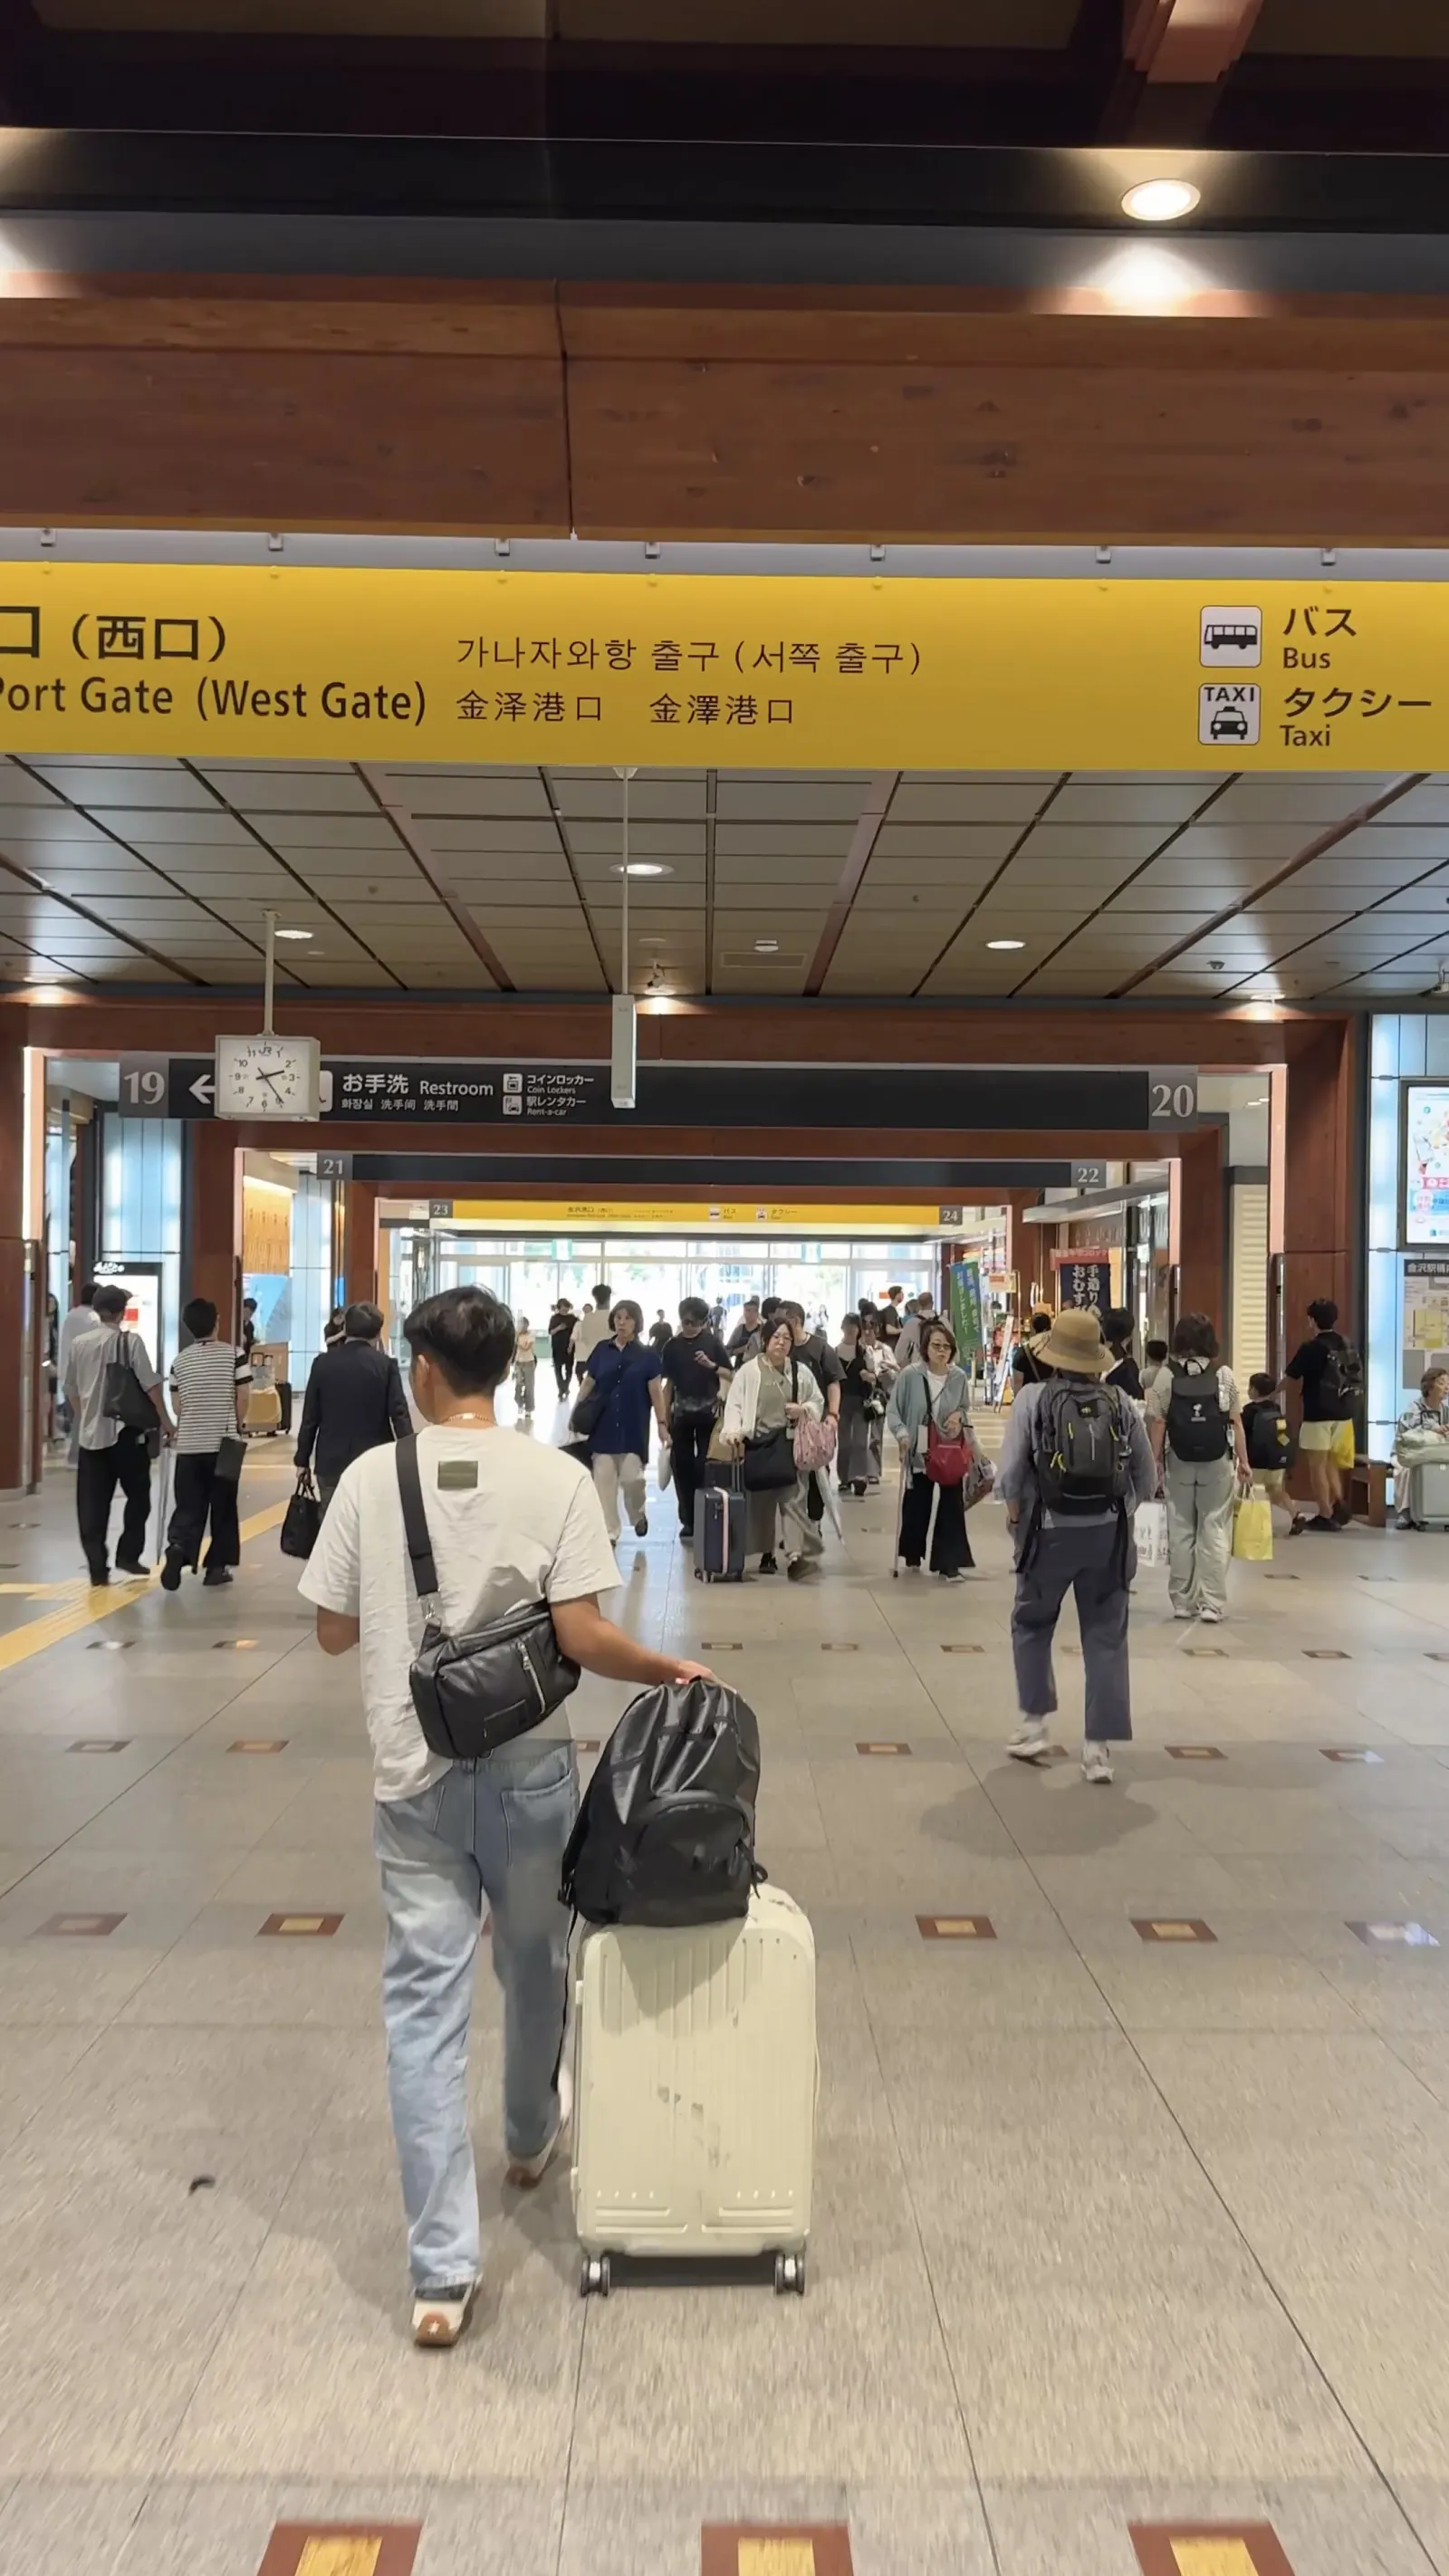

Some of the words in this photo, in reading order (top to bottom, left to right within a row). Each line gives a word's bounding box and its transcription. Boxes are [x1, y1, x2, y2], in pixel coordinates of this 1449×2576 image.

[1282, 606, 1357, 638] バス
[456, 636, 638, 670] 가나자와항
[651, 639, 720, 672] 출구
[734, 640, 820, 674] (서쪽
[835, 642, 921, 676] 출구)
[1282, 647, 1331, 670] Bus
[81, 676, 173, 715] Gate
[197, 678, 308, 722] (West
[321, 679, 426, 726] Gate)
[1204, 687, 1255, 703] TAXI
[1284, 687, 1433, 718] タクシー
[456, 689, 602, 723] 金泽港口
[649, 693, 793, 726] 金澤港口
[1280, 724, 1331, 748] Taxi
[238, 1059, 248, 1068] 10
[285, 1060, 292, 1069] 2
[235, 1072, 242, 1081] 9
[289, 1073, 295, 1081] 3
[342, 1073, 409, 1094] お手洗
[527, 1074, 595, 1085] コインロッカー
[123, 1071, 165, 1104] 19
[238, 1086, 245, 1094] 8
[285, 1087, 291, 1095] 4
[419, 1080, 494, 1096] Restroom
[527, 1086, 545, 1094] Coin
[547, 1087, 576, 1095] Lockers
[247, 1096, 254, 1104] 7
[261, 1100, 268, 1109] 6
[526, 1095, 587, 1108] 駅レンタカー
[1151, 1084, 1195, 1119] 20
[323, 1158, 343, 1175] 21
[1078, 1167, 1099, 1184] 22
[435, 1204, 449, 1217] 23
[943, 1209, 959, 1224] 24
